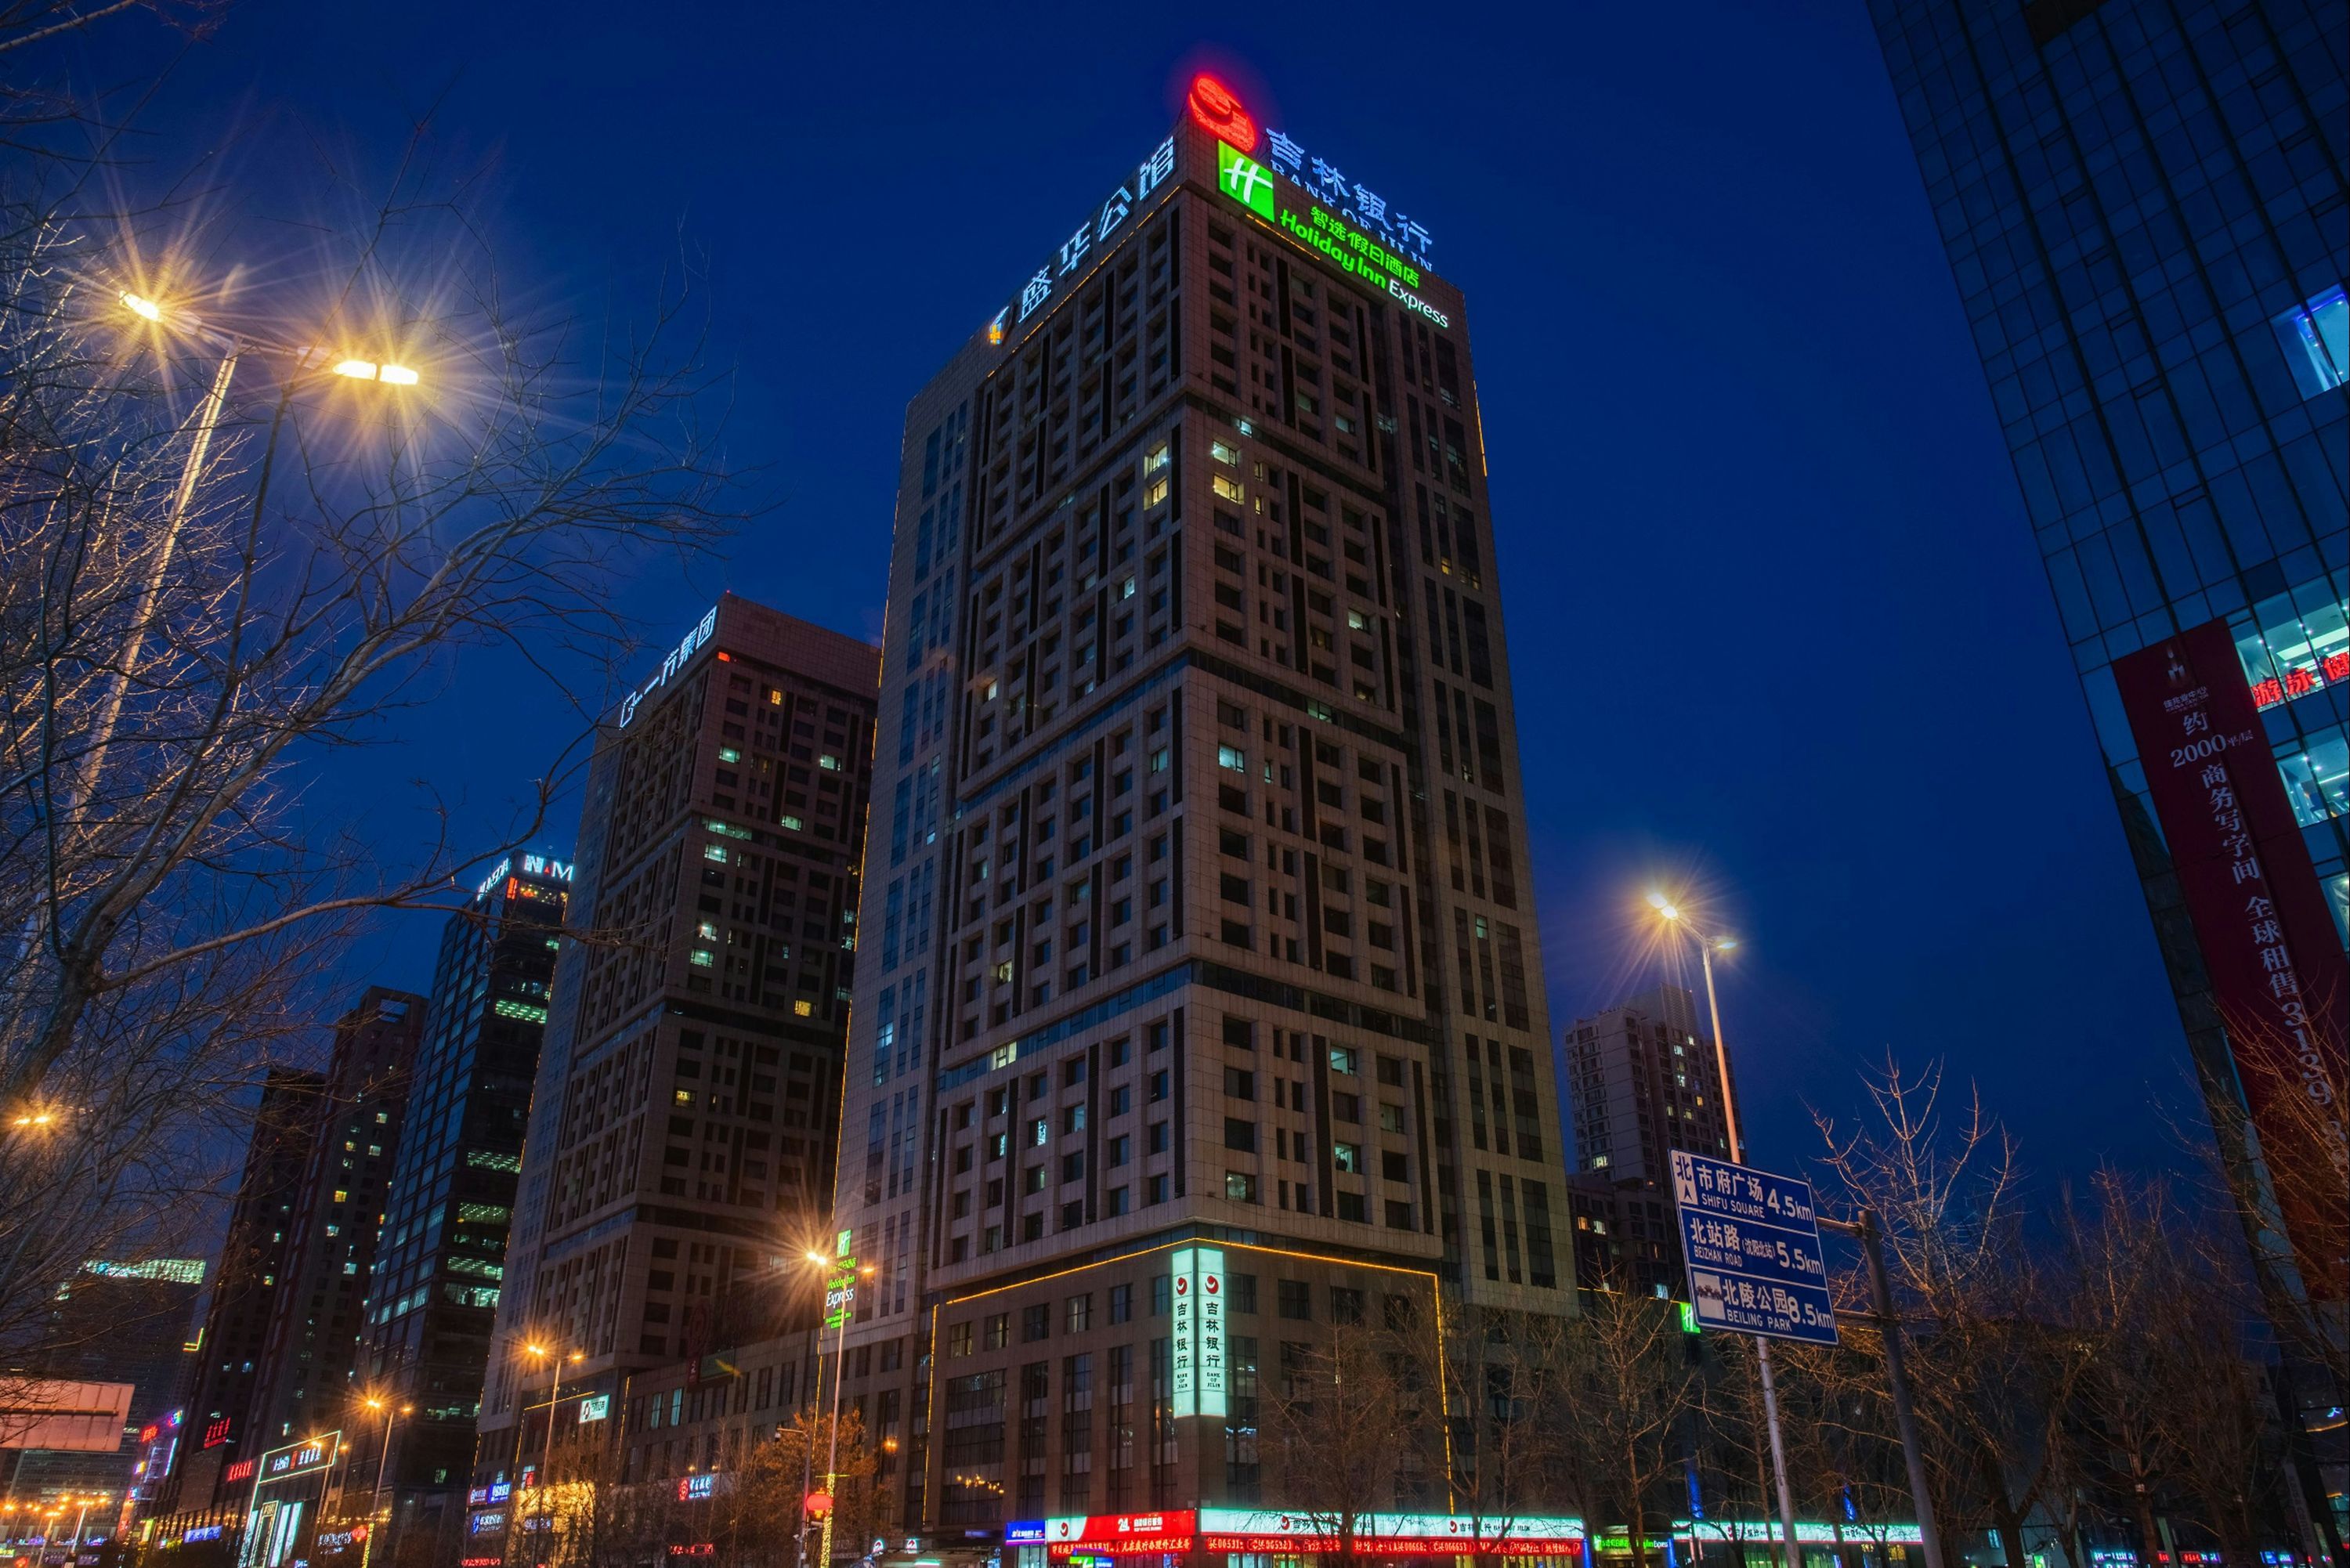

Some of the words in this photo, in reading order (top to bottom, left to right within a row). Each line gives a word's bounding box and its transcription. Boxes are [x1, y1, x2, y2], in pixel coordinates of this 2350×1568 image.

[1266, 128, 1433, 254] 吉林银行
[1018, 136, 1174, 324] 盛华公馆
[1310, 206, 1419, 289] 智选假日酒店
[1280, 208, 1356, 273] Holiday
[1357, 256, 1386, 290] Inn
[1388, 278, 1449, 329] Express
[2183, 710, 2208, 737] 约
[2200, 763, 2261, 885] 商务写字间
[1676, 1154, 1693, 1180] 北
[1696, 1164, 1763, 1203] 市府广场
[1767, 1188, 1813, 1223] 4.5km
[1701, 1193, 1728, 1211] SHIFU
[1730, 1199, 1766, 1219] SQUARE
[1690, 1216, 1741, 1252] 北站路
[1777, 1241, 1823, 1277] 5.5km
[1694, 1245, 1723, 1263] BEIZHAN
[1725, 1252, 1743, 1268] ROAD
[1206, 1302, 1220, 1367] 吉林银行
[1722, 1278, 1789, 1317] 北陵公园
[1787, 1295, 1834, 1330] 8.5km
[1726, 1309, 1763, 1328] BEILING
[1767, 1317, 1792, 1332] PARK
[1177, 1302, 1188, 1368] 吉林银行
